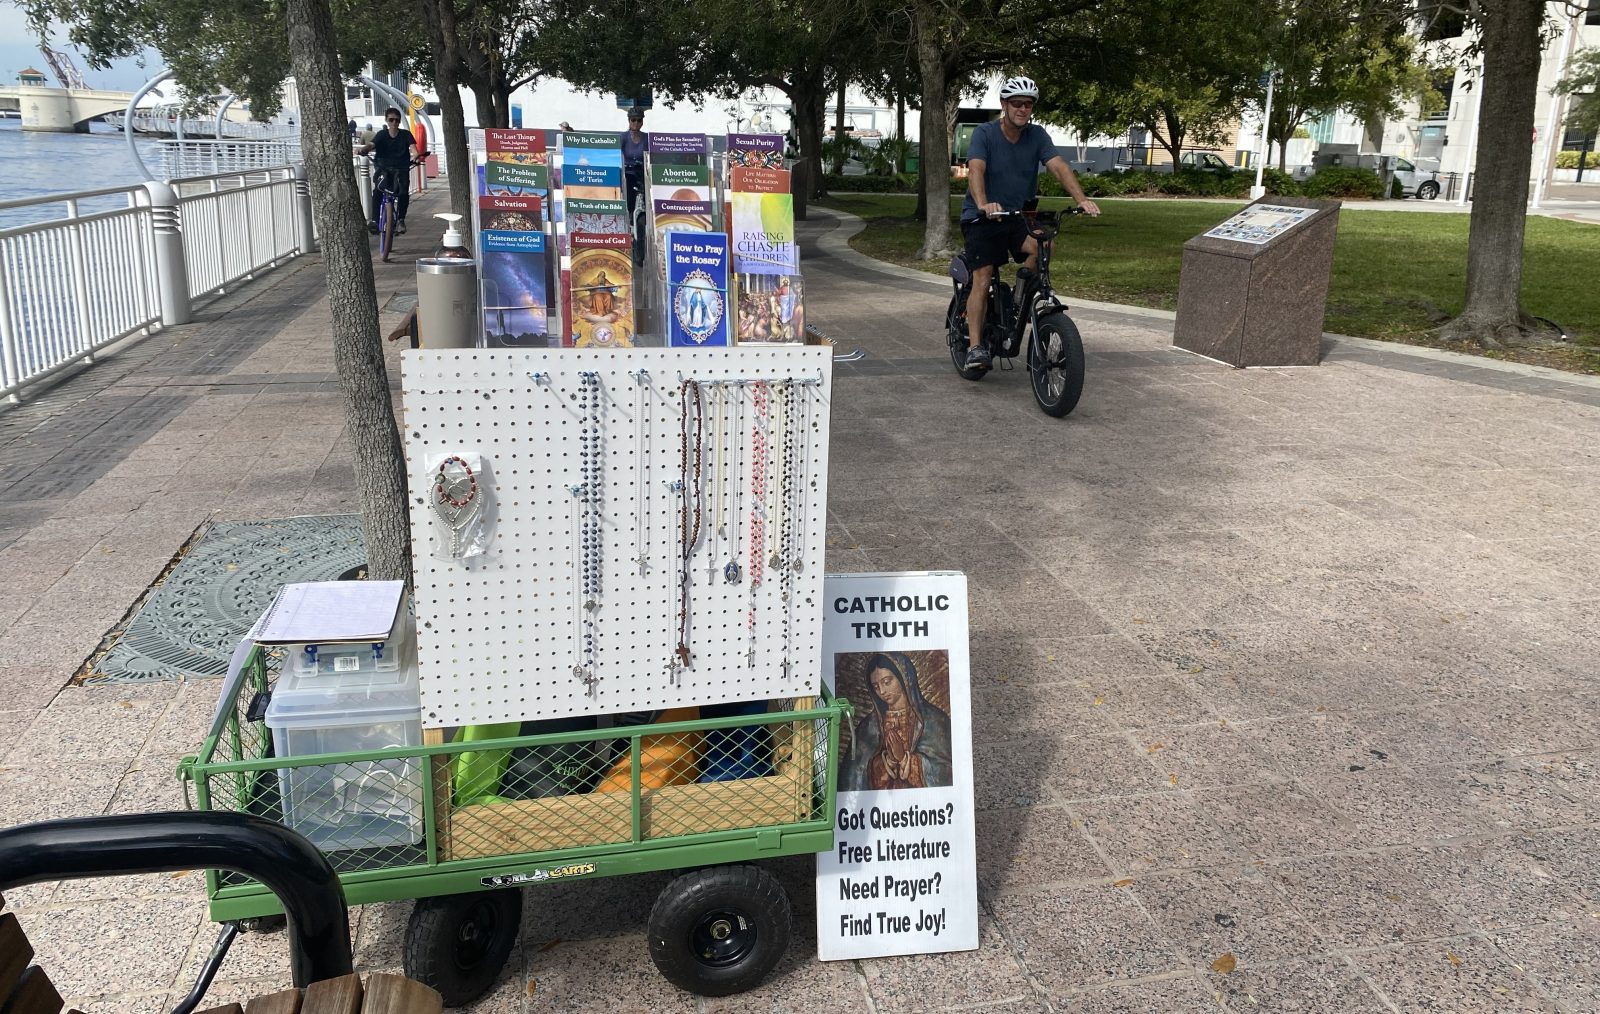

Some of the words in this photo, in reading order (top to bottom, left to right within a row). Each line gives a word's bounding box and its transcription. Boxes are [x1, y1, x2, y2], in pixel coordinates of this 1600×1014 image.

[517, 134, 536, 142] Things
[566, 135, 580, 145] Why
[581, 136, 590, 144] Be
[590, 137, 617, 145] Catholic?
[735, 137, 755, 146] Sexual
[756, 139, 775, 148] Purity
[497, 166, 510, 174] The
[511, 168, 537, 177] Problem
[575, 168, 586, 176] The
[662, 168, 697, 177] Abortion
[506, 176, 536, 186] Suffering
[494, 199, 528, 208] Salvation
[661, 202, 705, 213] Contraception
[487, 234, 518, 242] Existence
[525, 235, 541, 243] God
[575, 236, 604, 244] Existence
[743, 231, 784, 241] RAISING
[673, 243, 693, 253] How
[693, 244, 704, 253] to
[705, 245, 724, 256] Pray
[737, 241, 790, 252] CHASTE
[675, 255, 691, 264] the
[691, 255, 721, 267] Rosary
[738, 253, 790, 262] CHILDREN
[833, 594, 950, 614] CATHOLIC
[851, 620, 929, 639] TRUTH
[838, 807, 866, 831] Got
[869, 802, 954, 831] Questions?
[838, 841, 873, 864] Free
[876, 837, 951, 862] Literature
[839, 876, 879, 901] Need
[884, 871, 942, 902] Prayer?
[840, 913, 872, 937] Find
[876, 912, 911, 934] True
[915, 907, 946, 936] Joy!
